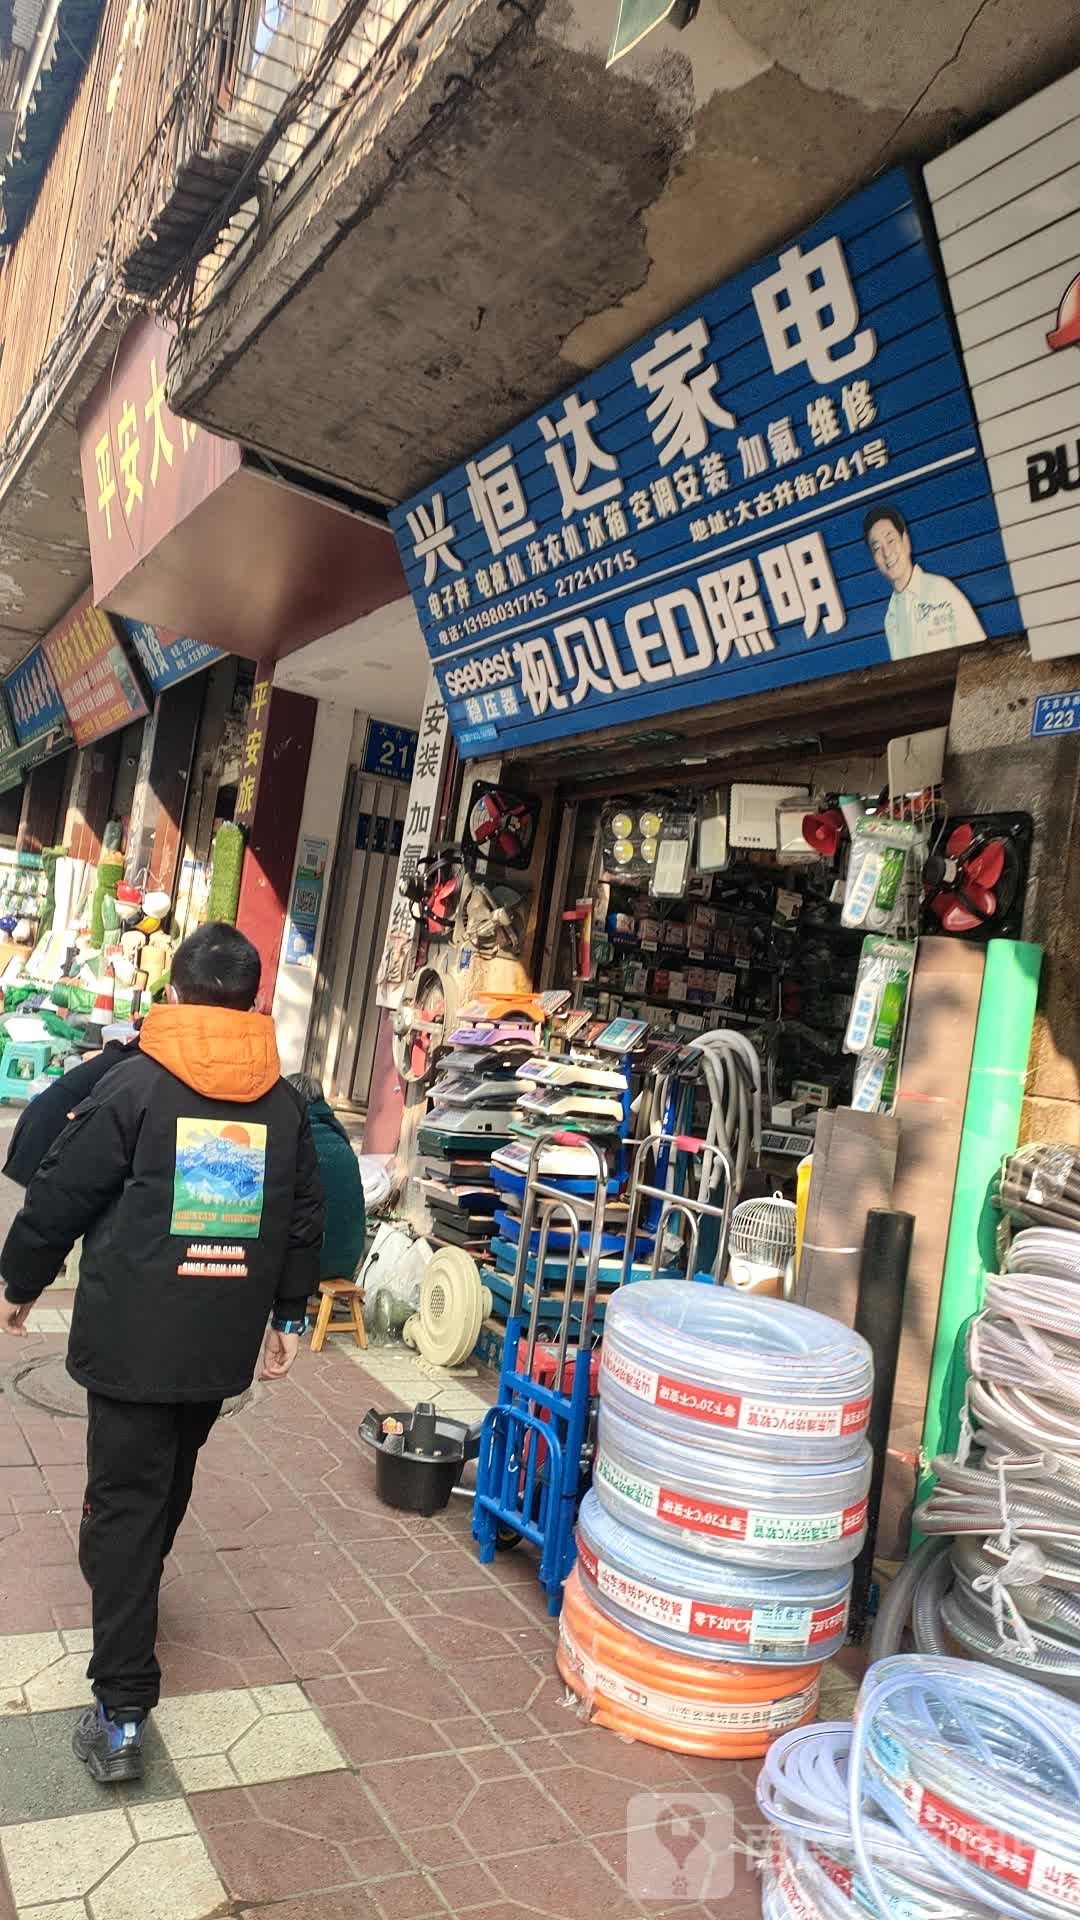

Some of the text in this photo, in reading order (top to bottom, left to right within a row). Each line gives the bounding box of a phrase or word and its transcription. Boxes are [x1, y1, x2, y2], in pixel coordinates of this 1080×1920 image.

[405, 235, 877, 588] 兴恒达家电
[95, 356, 197, 541] 平安大
[1026, 439, 1080, 503] BU
[428, 577, 471, 621] 电子秤
[475, 553, 527, 598] 电视机
[525, 524, 585, 575] 洗衣机
[583, 500, 629, 550] 冰箱
[628, 450, 730, 530] 空调安装
[806, 379, 878, 447] 维修
[554, 548, 638, 598] 27211715
[445, 648, 515, 697] seebest
[415, 700, 447, 777] 安装
[1042, 709, 1075, 730] 223
[190, 1243, 212, 1255] MADE
